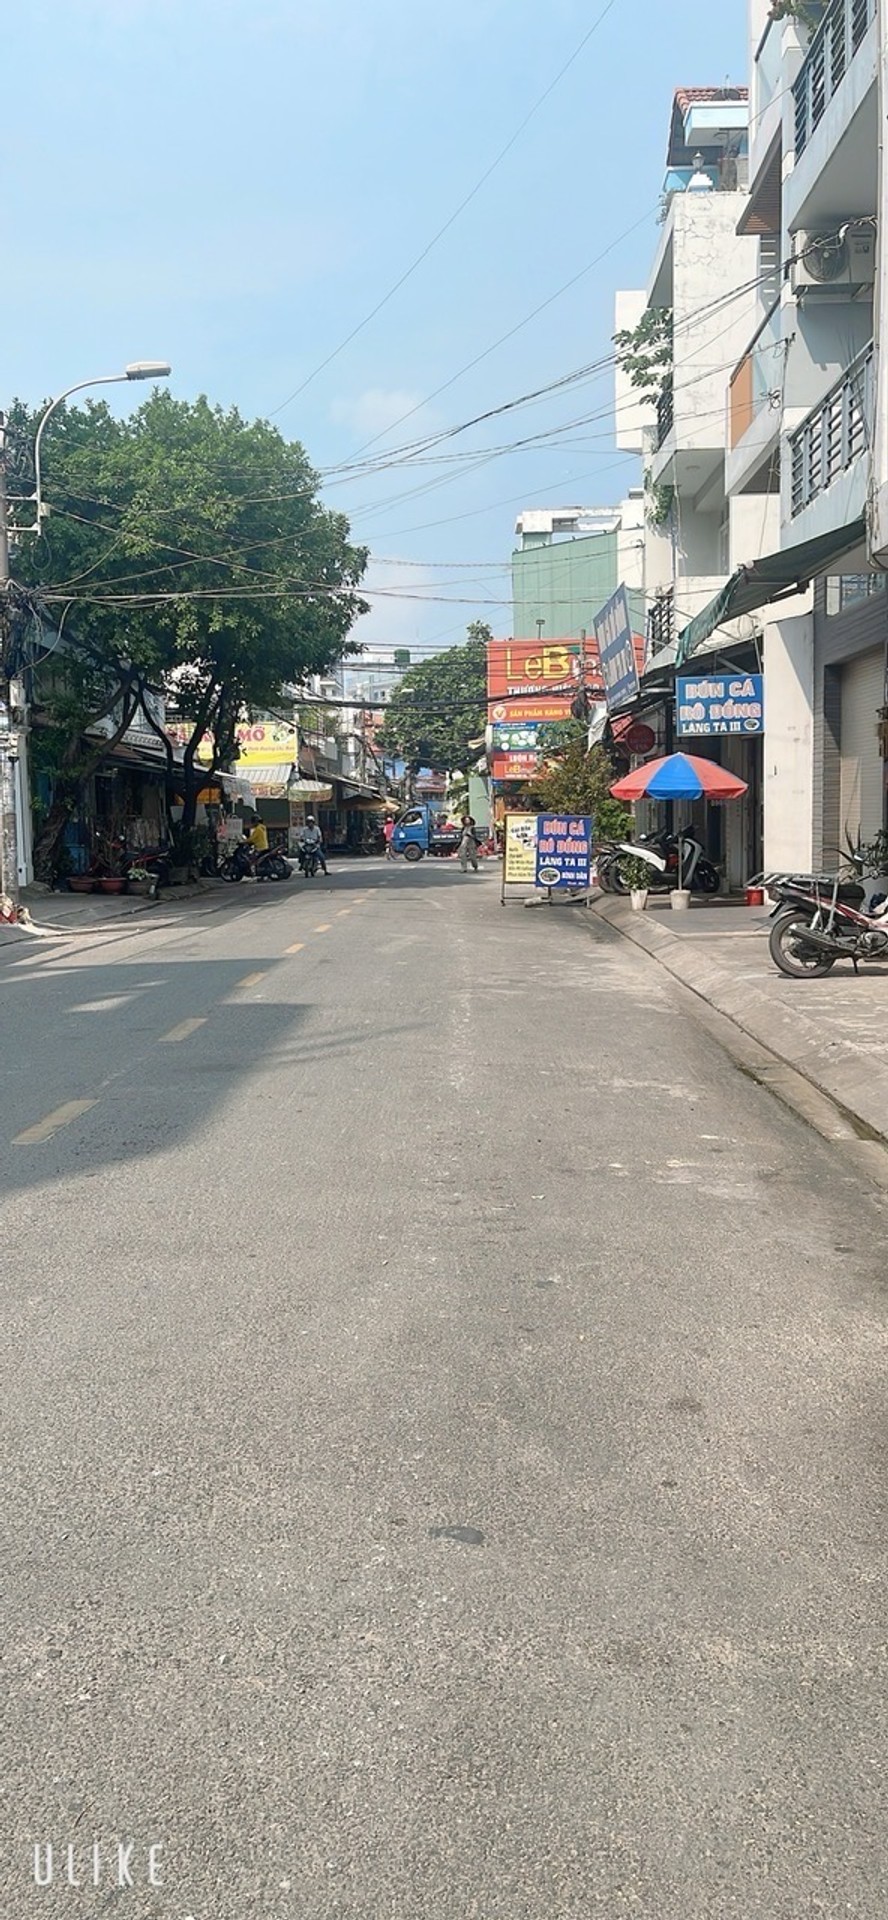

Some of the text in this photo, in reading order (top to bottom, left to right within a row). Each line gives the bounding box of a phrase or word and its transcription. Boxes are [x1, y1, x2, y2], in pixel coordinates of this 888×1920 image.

[729, 678, 756, 698] CÁ
[679, 702, 706, 721] RÔ
[712, 721, 728, 732] TA
[569, 819, 586, 837] CÁ
[564, 858, 576, 867] TA
